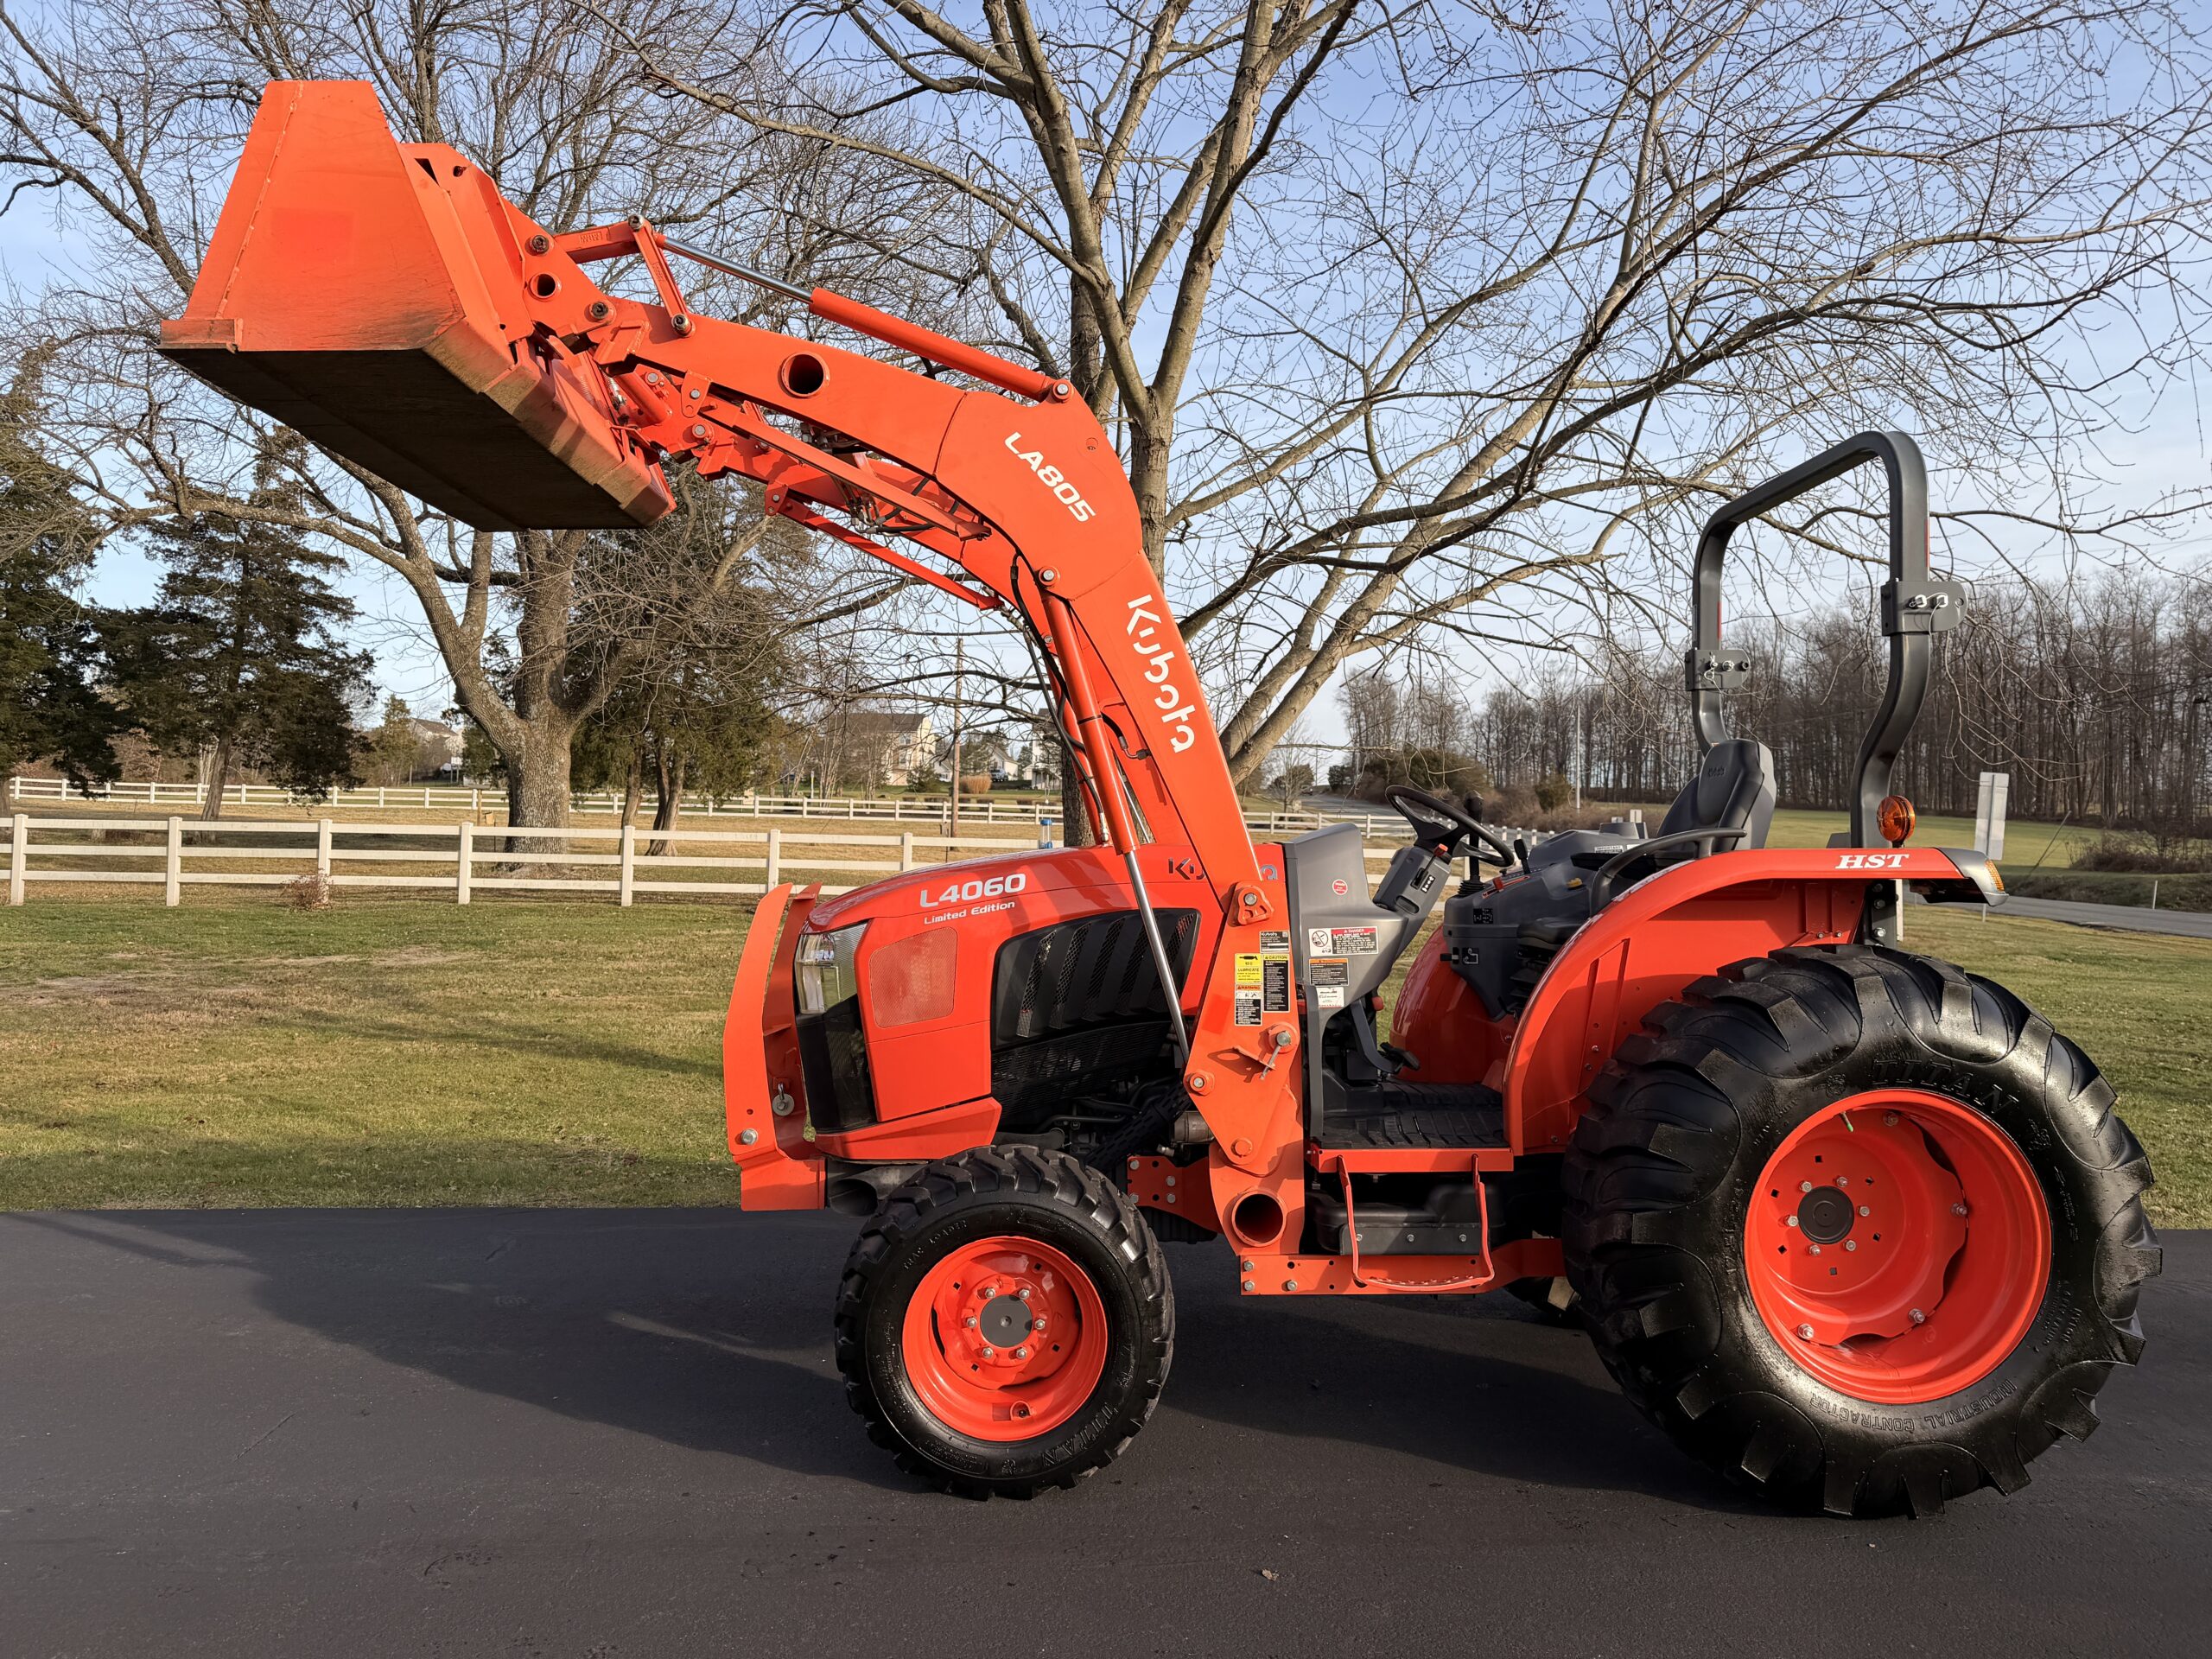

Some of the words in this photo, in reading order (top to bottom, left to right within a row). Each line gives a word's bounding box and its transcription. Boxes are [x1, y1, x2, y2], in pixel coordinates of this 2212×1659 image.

[1004, 431, 1096, 522] LA805
[1127, 594, 1196, 753] Kubota
[1834, 854, 1910, 869] HST
[919, 873, 1027, 907] L4060
[924, 909, 967, 925] Limited
[970, 901, 1015, 915] Edition
[1872, 1058, 2019, 1115] TITAN
[1809, 1392, 1916, 1432] CONTRACTOR
[1924, 1379, 2018, 1428] INDUSTRIAL
[1042, 1402, 1119, 1467] TITAN
